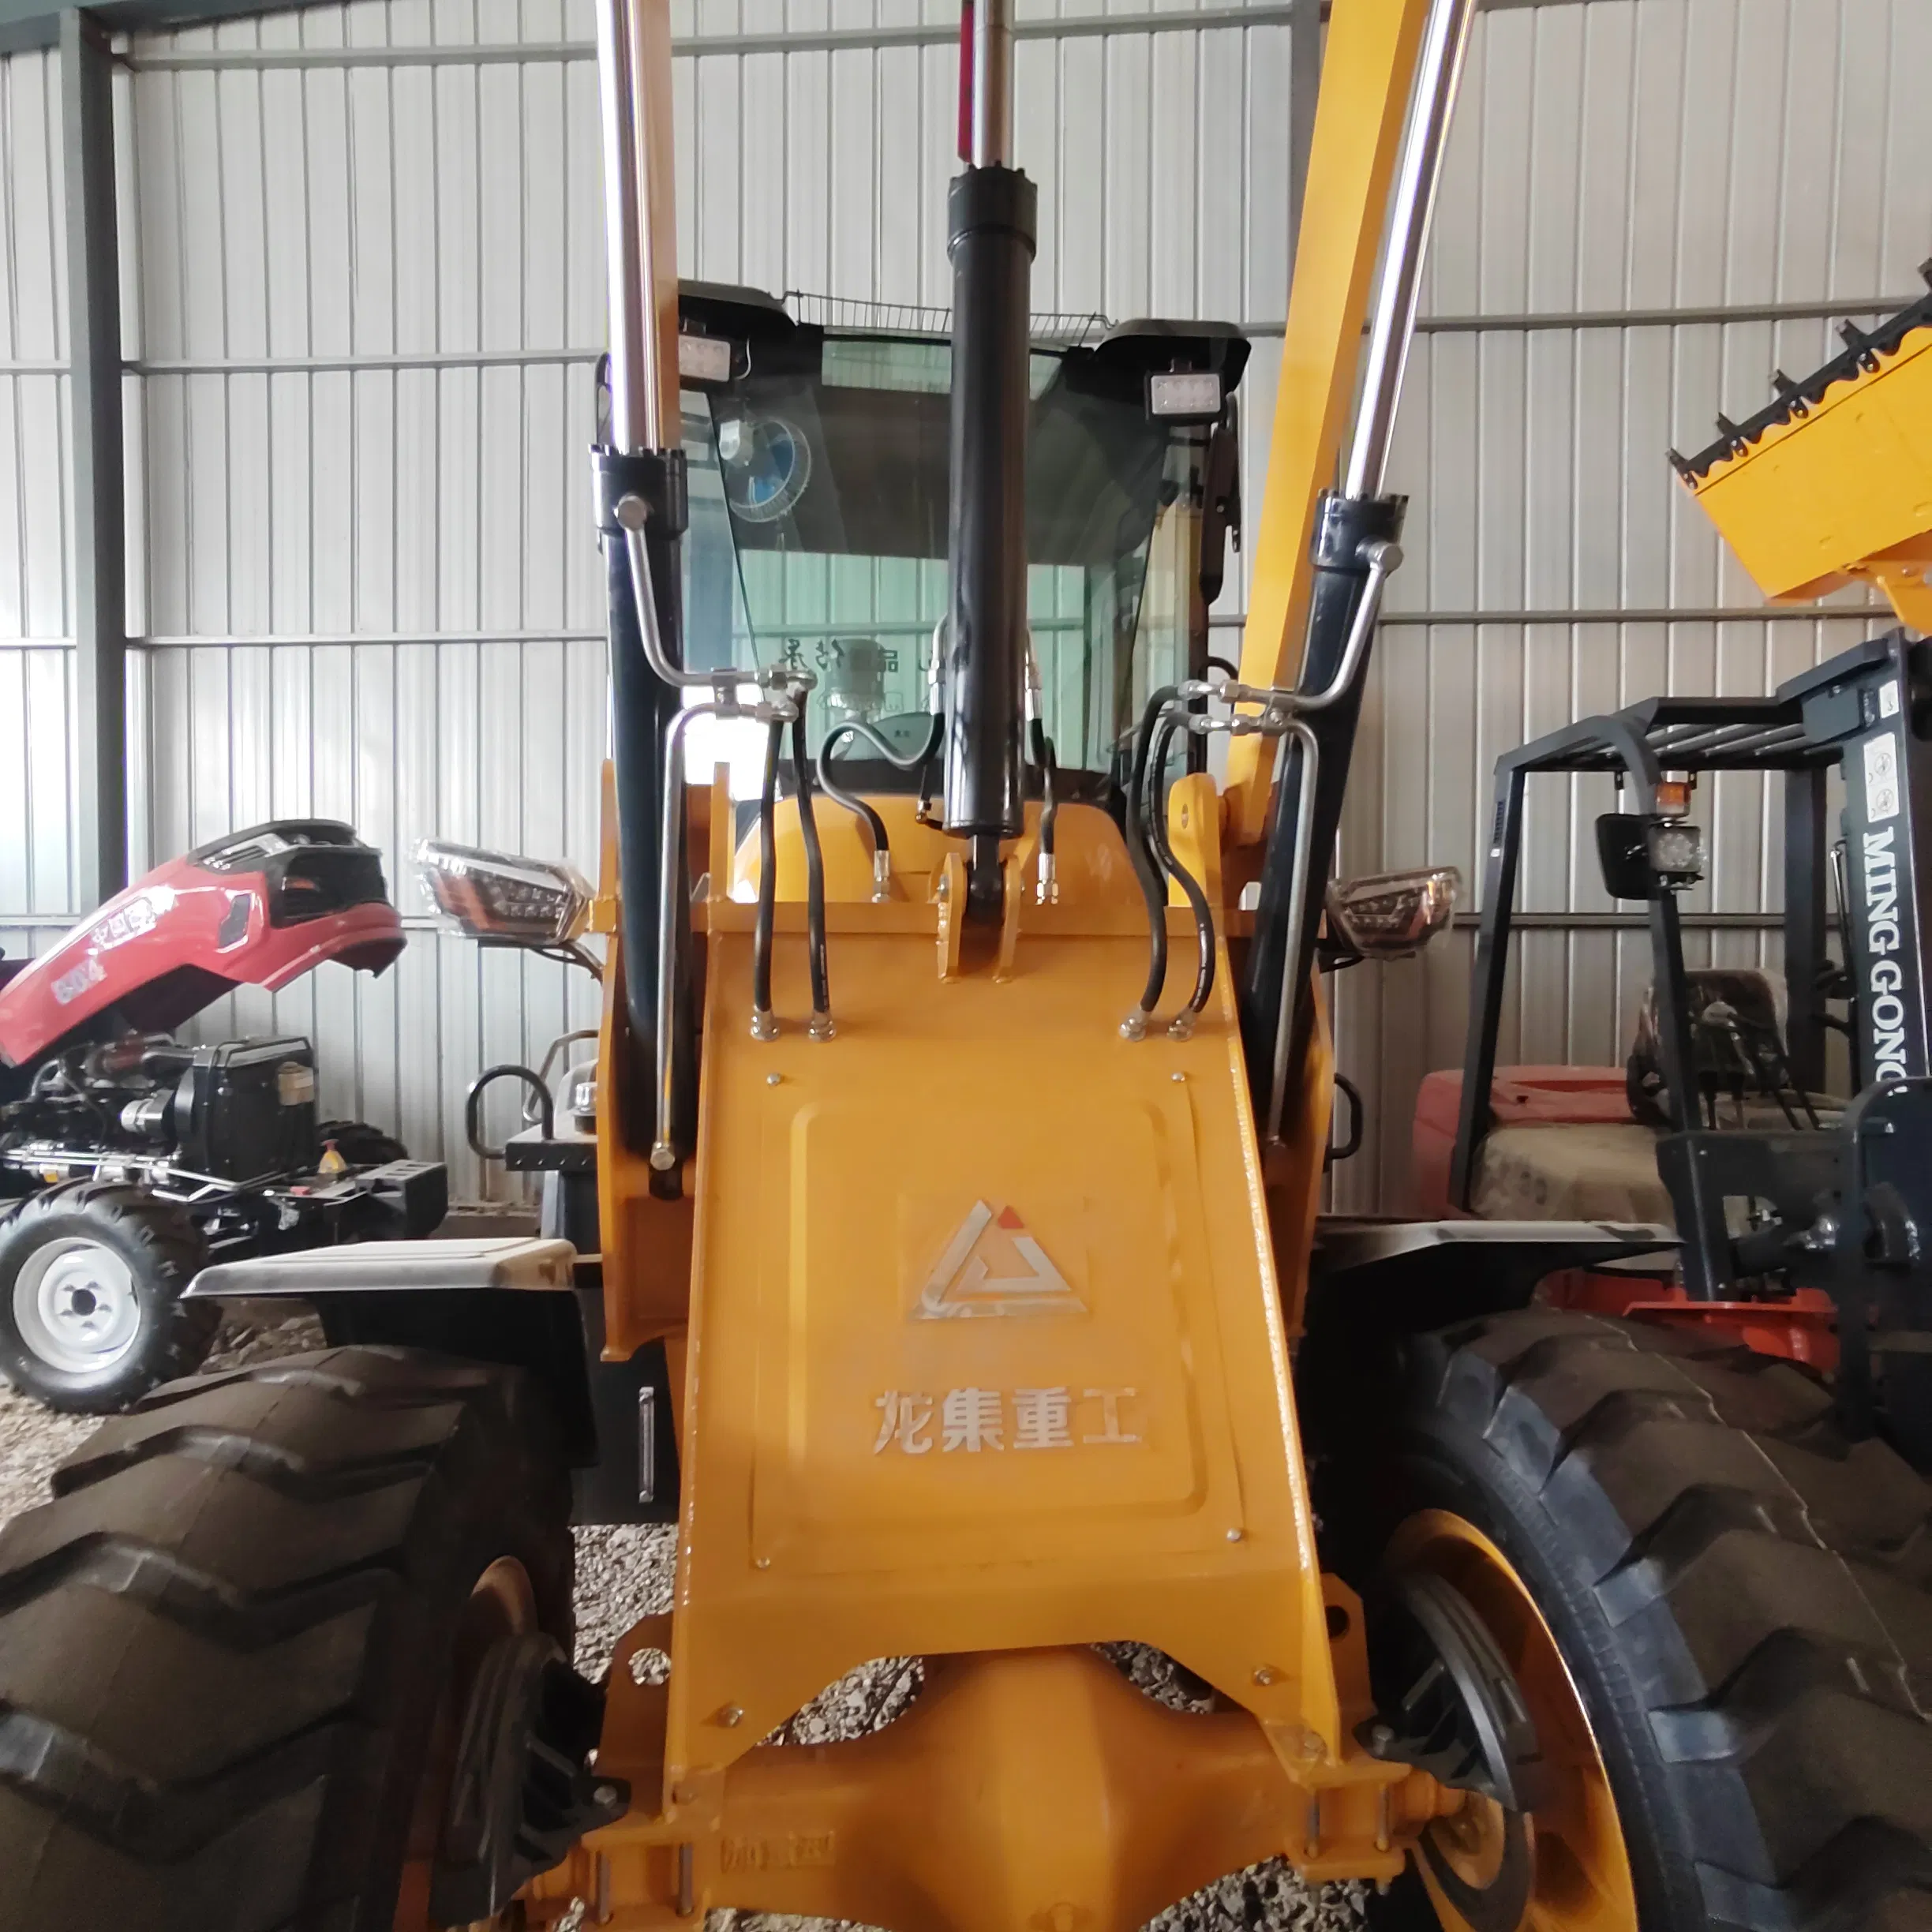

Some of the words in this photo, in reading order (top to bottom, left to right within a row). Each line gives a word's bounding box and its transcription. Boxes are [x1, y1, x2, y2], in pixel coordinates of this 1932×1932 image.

[1863, 826, 1900, 956] MING
[873, 1387, 1143, 1455] 龙集重工
